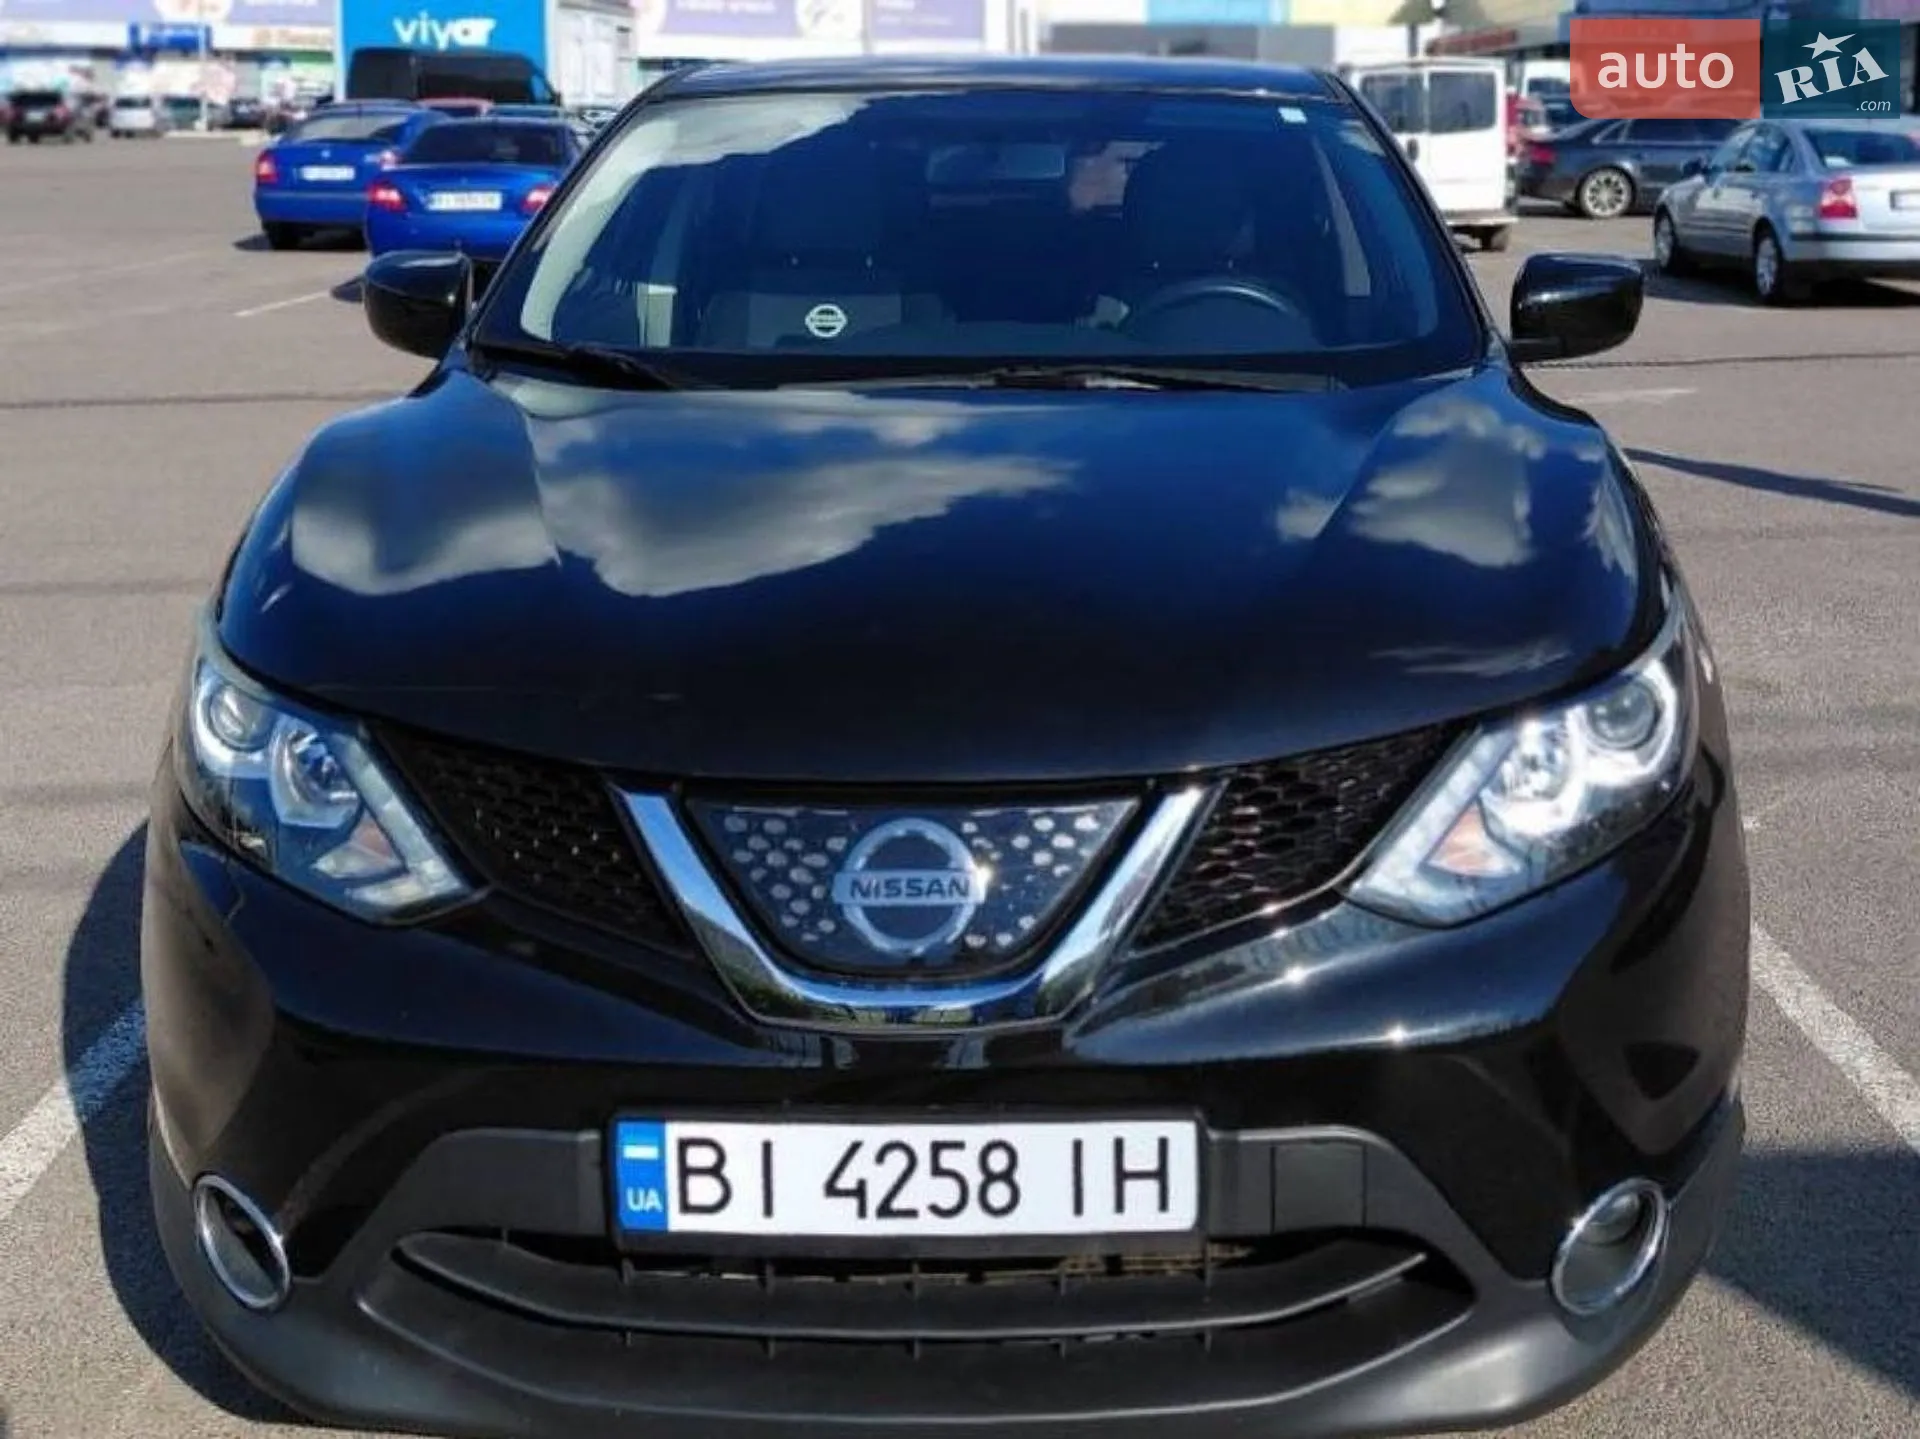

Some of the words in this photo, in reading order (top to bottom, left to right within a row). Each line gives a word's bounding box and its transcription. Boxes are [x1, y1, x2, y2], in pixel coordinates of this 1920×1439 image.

[851, 877, 969, 899] NISSAN
[677, 1137, 773, 1218] BI
[824, 1140, 1020, 1219] 4258
[1072, 1136, 1169, 1216] IH
[626, 1187, 663, 1212] UA
